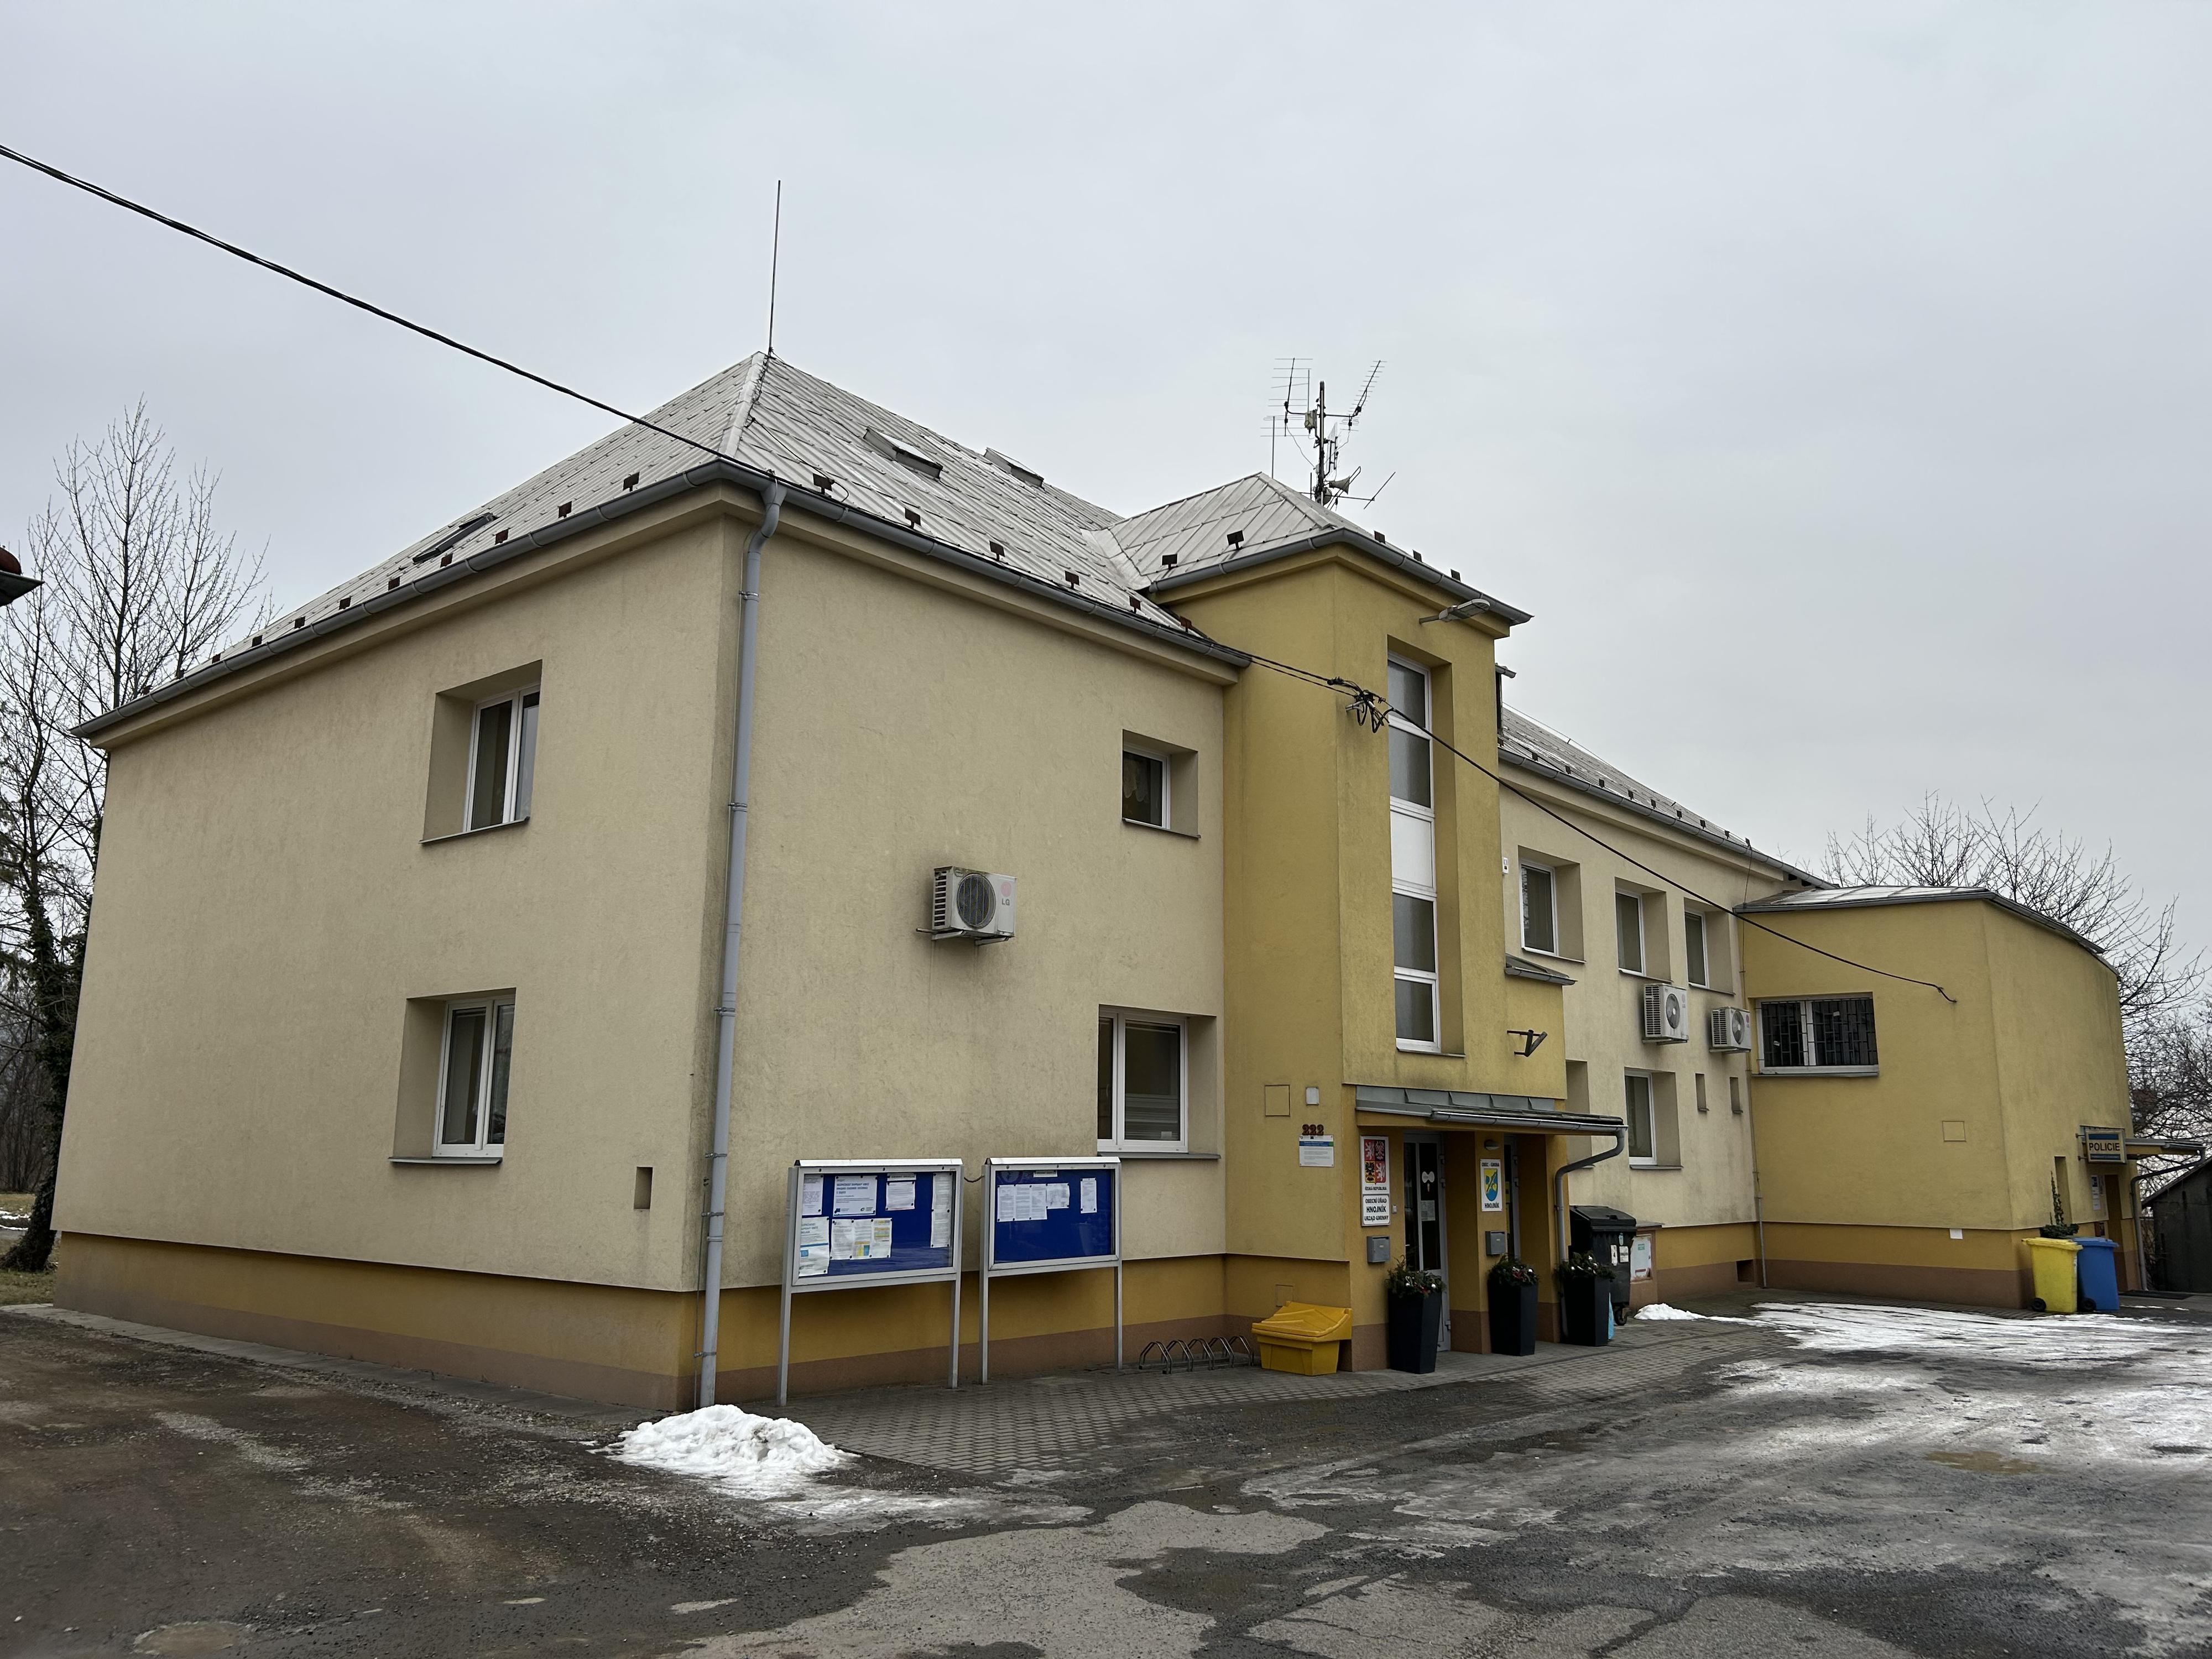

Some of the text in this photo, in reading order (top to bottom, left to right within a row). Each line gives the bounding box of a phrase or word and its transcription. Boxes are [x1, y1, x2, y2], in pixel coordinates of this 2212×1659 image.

[1302, 1124, 1324, 1135] 222
[2089, 1142, 2120, 1151] POLICIE
[1366, 1204, 1386, 1213] HNOJNÍK
